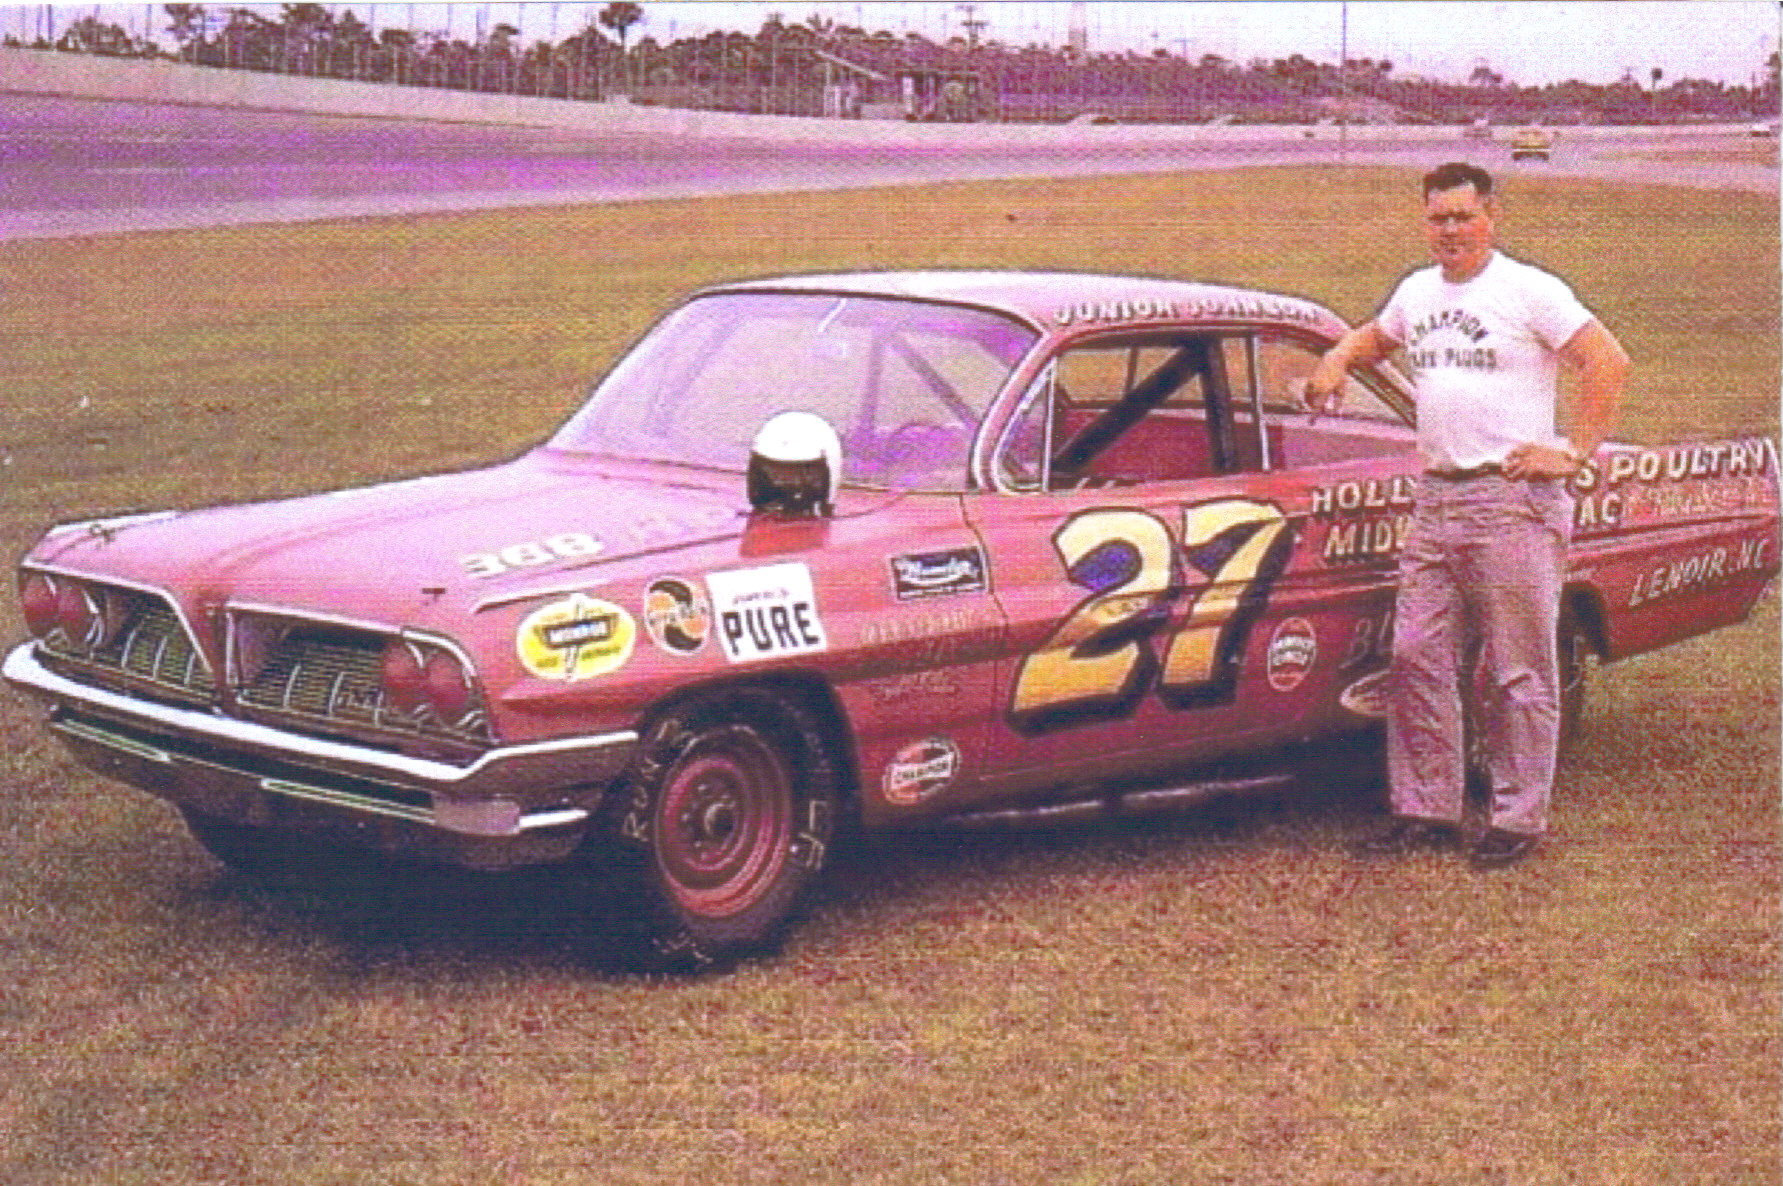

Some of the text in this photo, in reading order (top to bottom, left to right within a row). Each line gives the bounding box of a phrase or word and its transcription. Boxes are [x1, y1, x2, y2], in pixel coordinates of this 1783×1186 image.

[1609, 441, 1768, 484] POULTRY
[722, 602, 820, 656] PURE
[1006, 501, 1294, 736] 27
